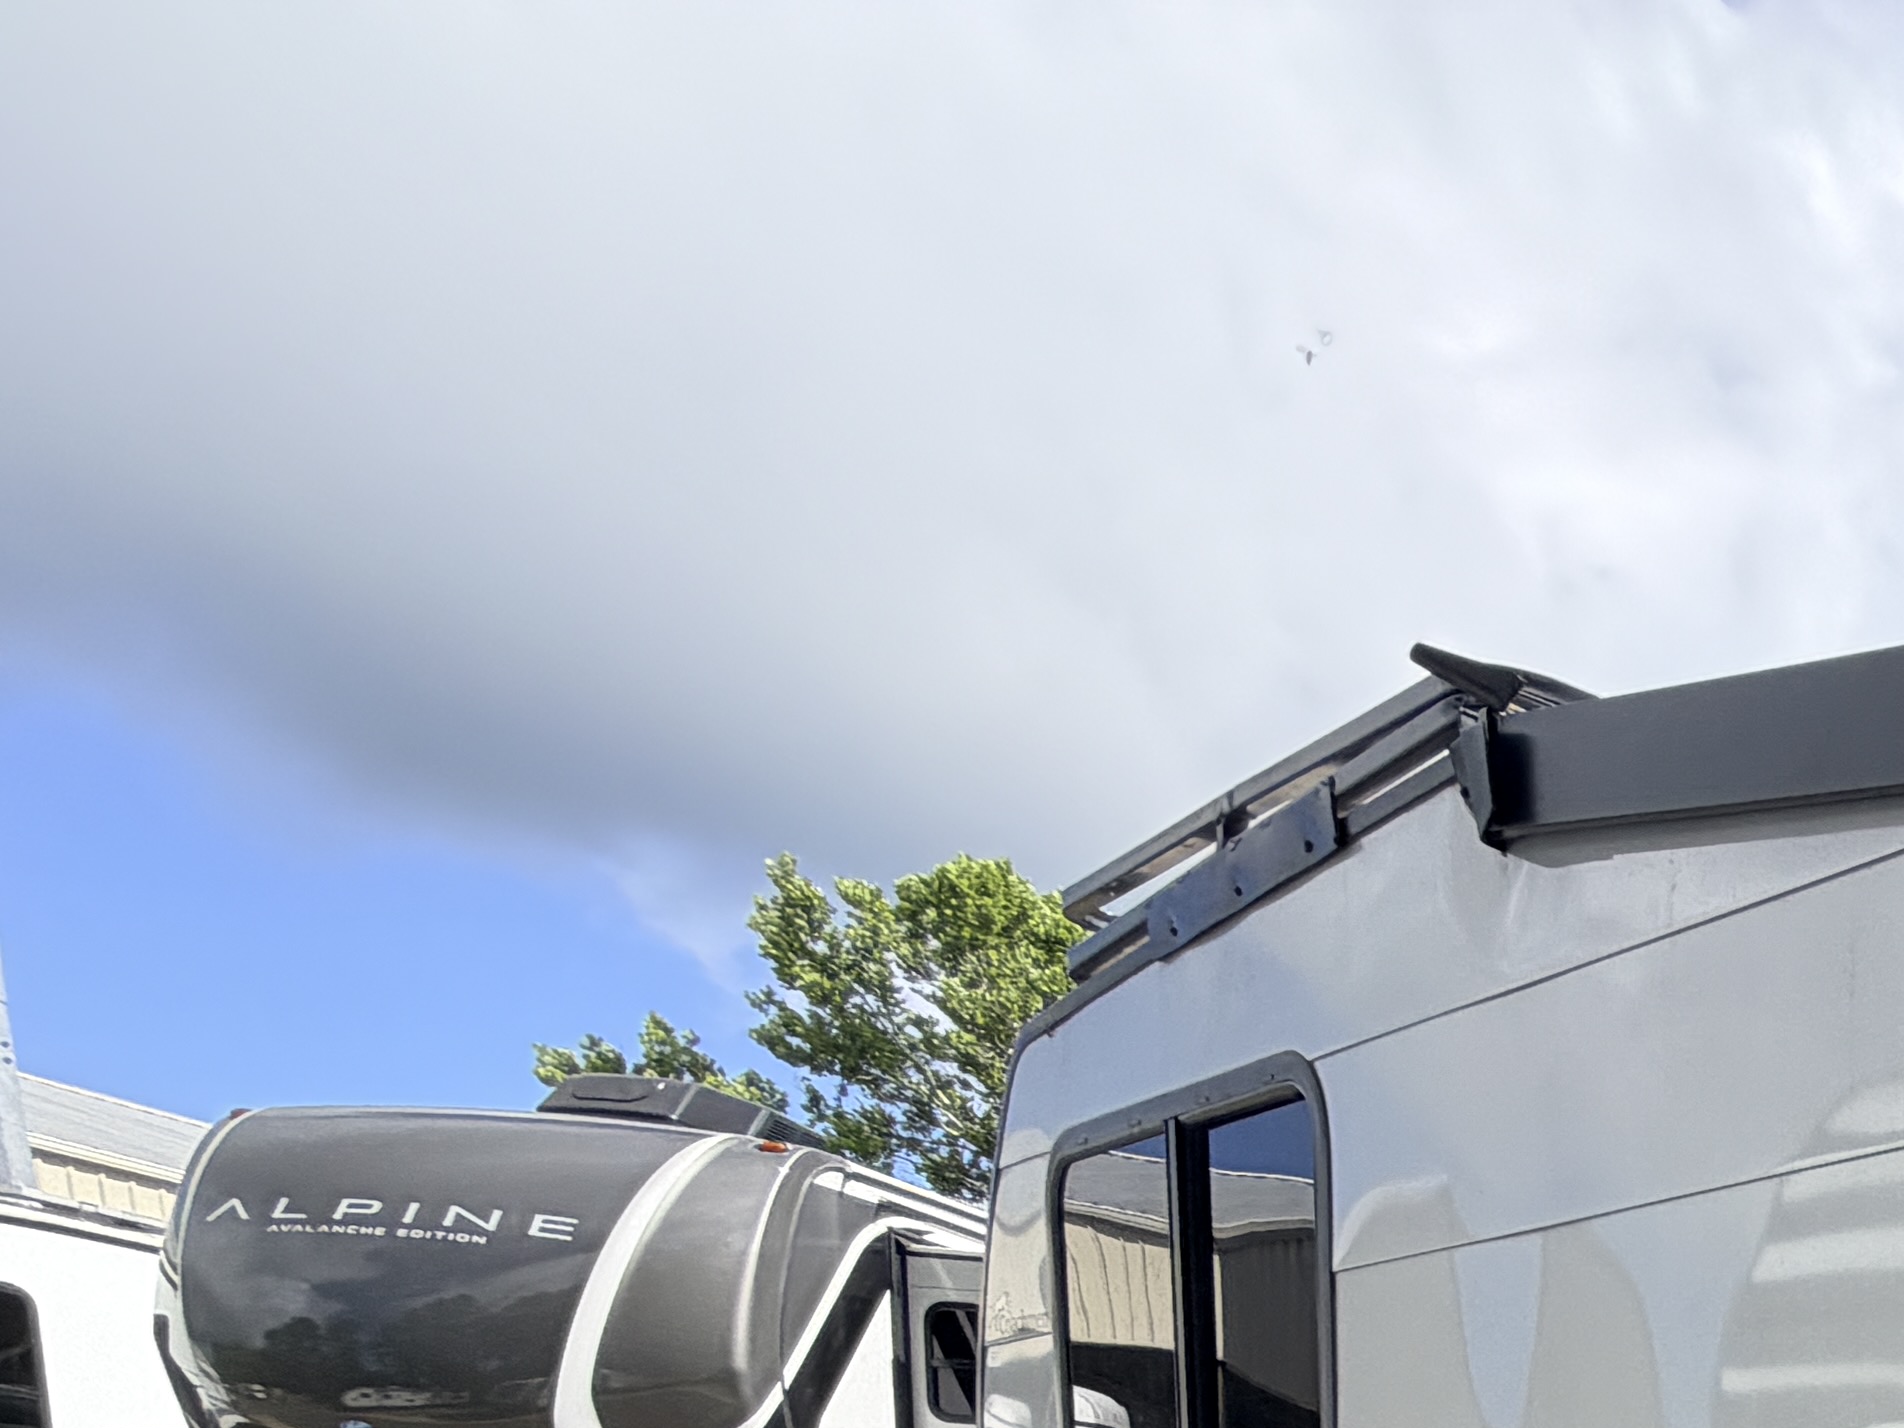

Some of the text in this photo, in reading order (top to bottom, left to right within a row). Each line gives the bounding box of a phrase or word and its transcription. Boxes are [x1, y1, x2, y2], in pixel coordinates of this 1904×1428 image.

[206, 1197, 580, 1241] ALPINE
[266, 1223, 489, 1244] AVALANCHE EDITION
